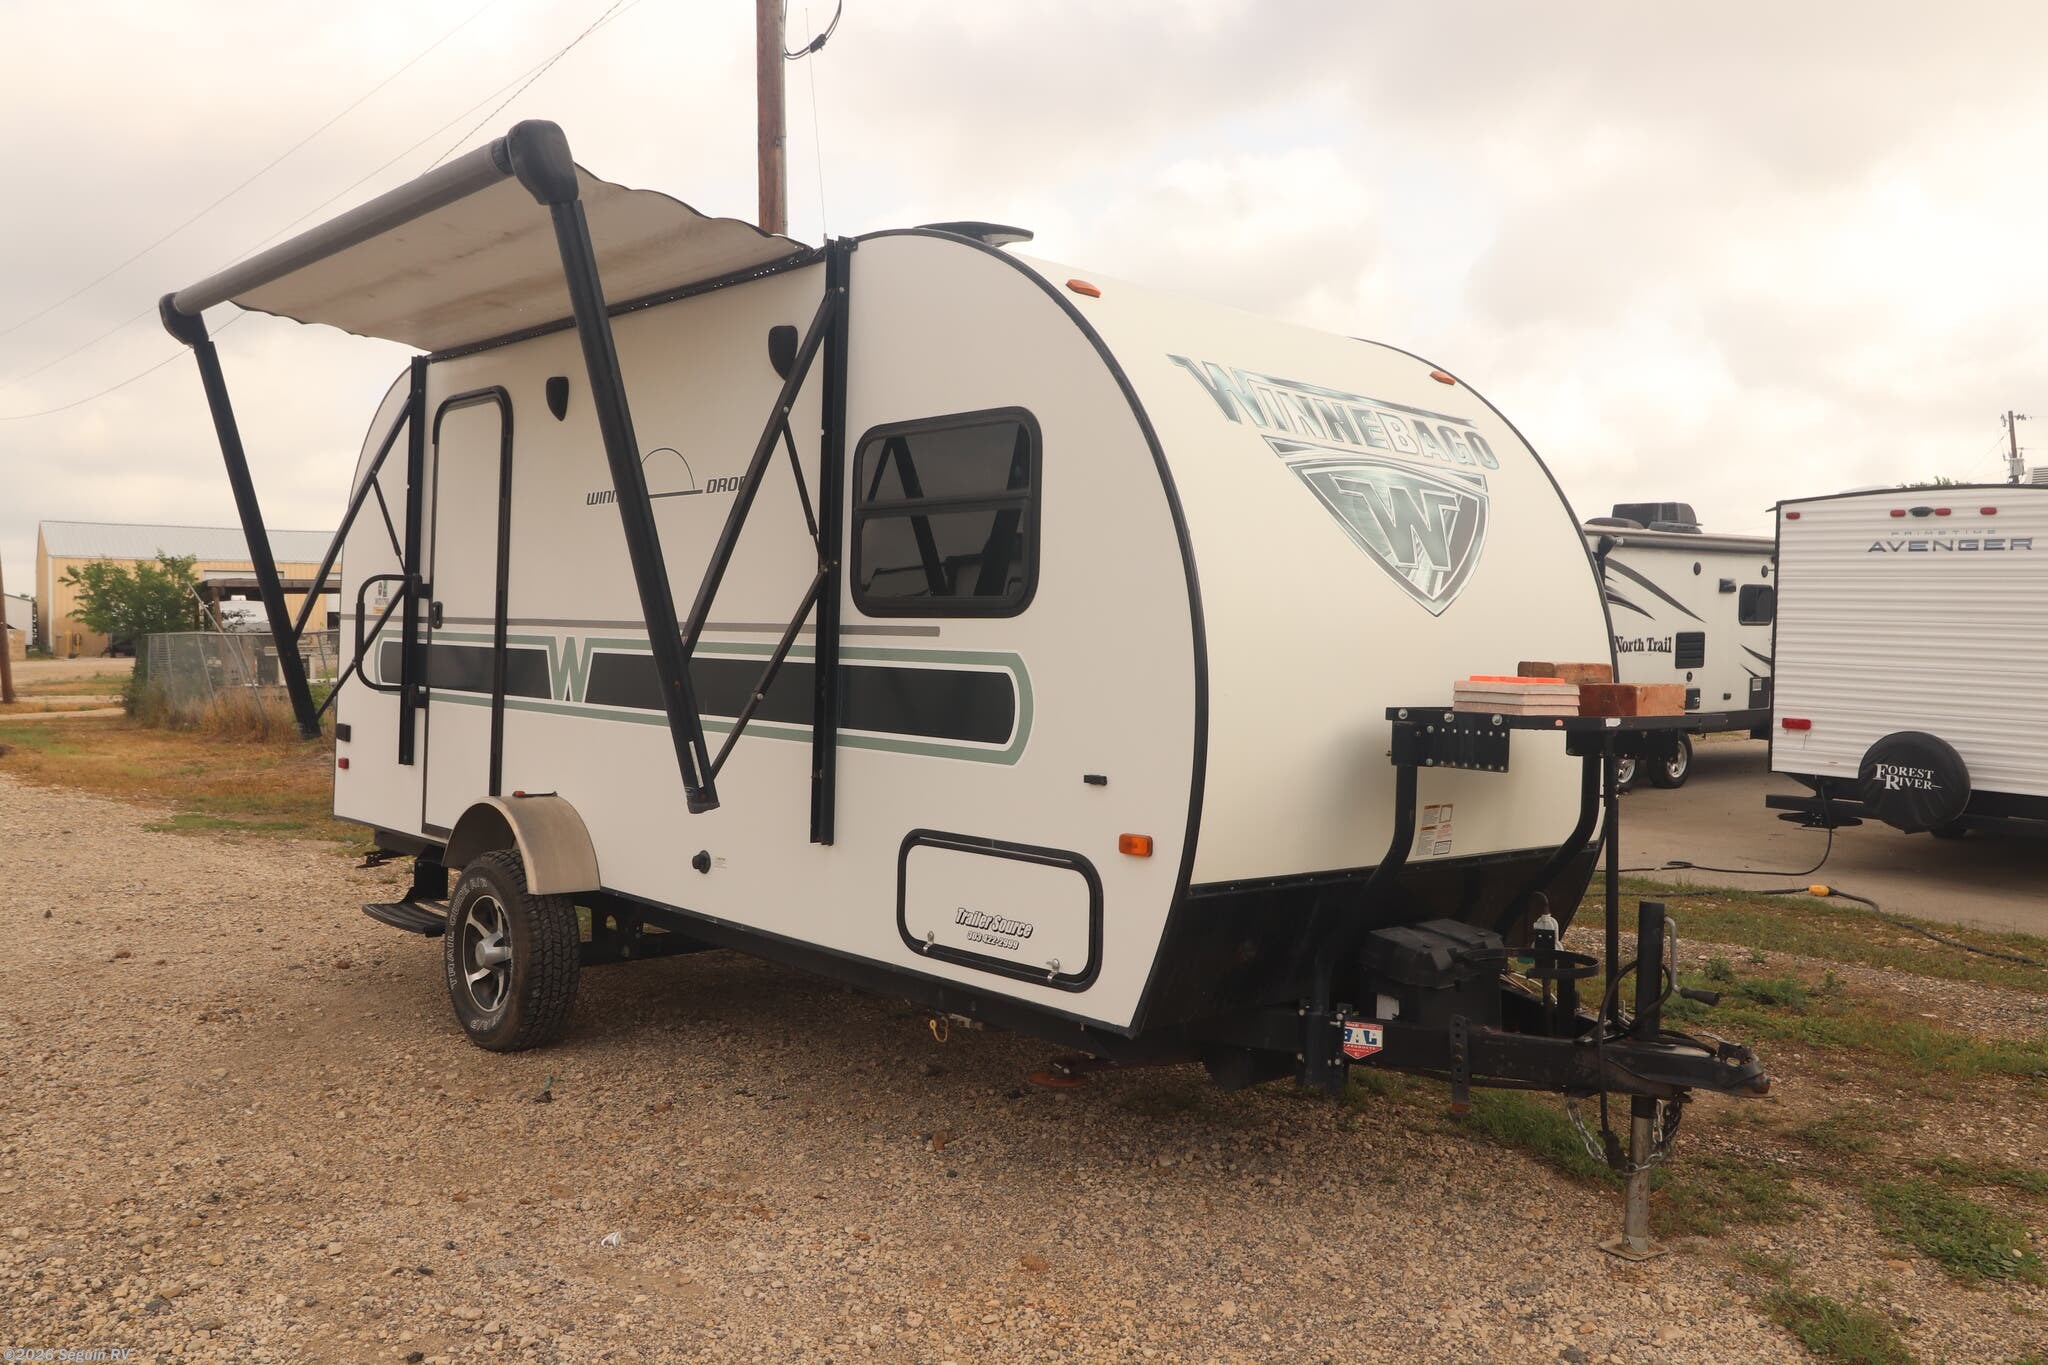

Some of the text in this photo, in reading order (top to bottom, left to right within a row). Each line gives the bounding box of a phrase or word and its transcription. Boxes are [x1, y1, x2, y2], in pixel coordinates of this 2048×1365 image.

[1166, 353, 1500, 470] WINNEBAGO
[1867, 537, 2033, 553] AVENGER
[1614, 635, 1672, 653] North Trail
[1872, 763, 1935, 780] FOREST
[1884, 774, 1938, 790] RIVER
